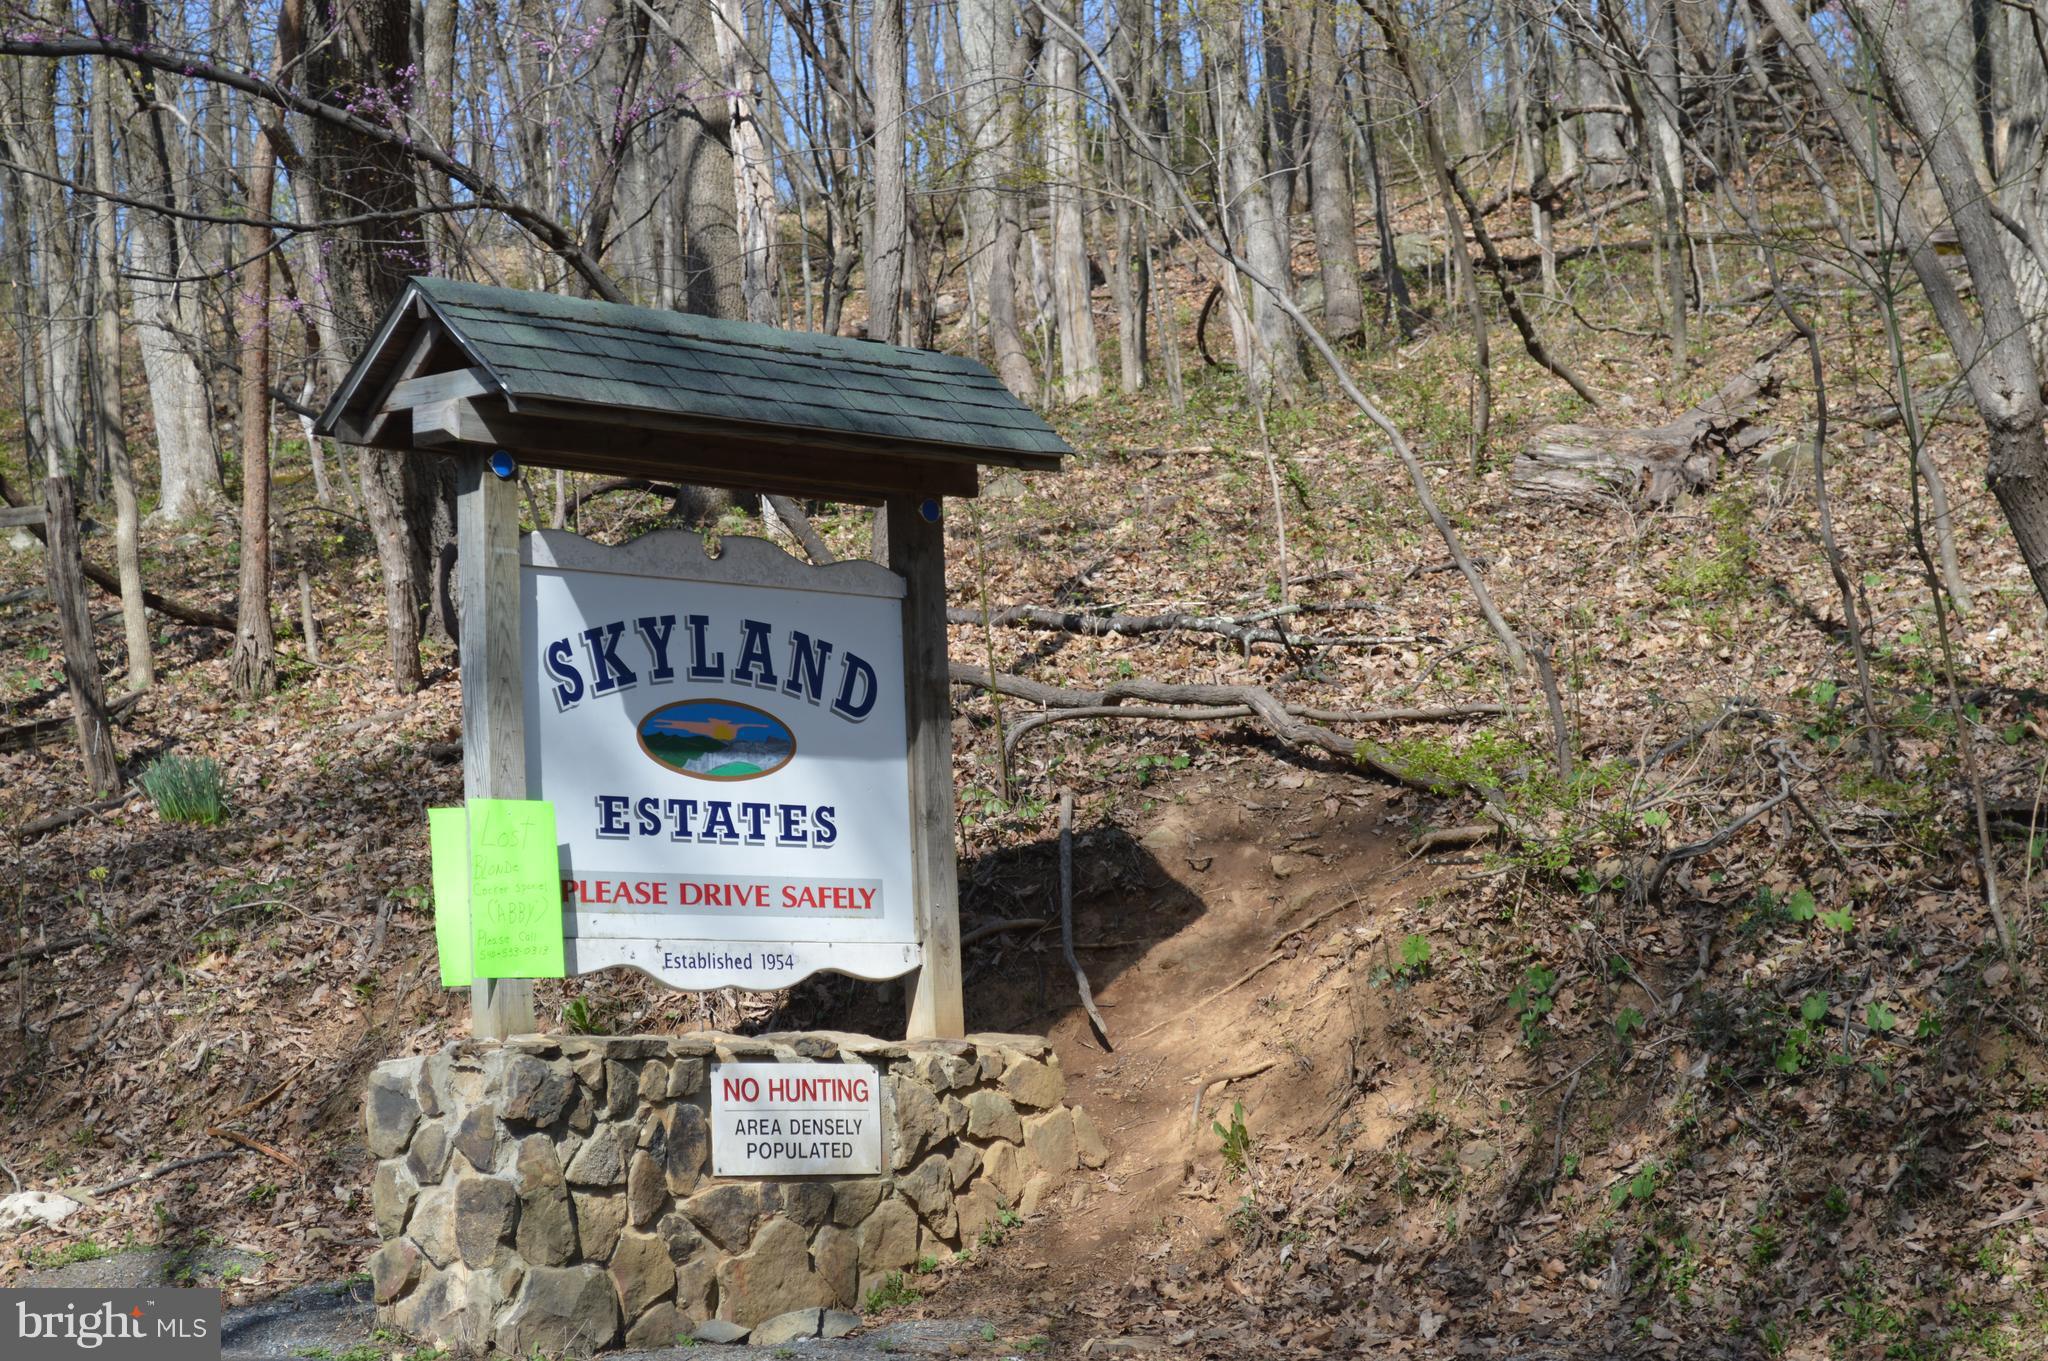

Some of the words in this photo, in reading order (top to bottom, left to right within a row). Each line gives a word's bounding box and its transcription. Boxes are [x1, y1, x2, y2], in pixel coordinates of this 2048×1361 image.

[544, 614, 878, 723] SKYLAND
[595, 795, 838, 848] ESTATES
[562, 879, 668, 905] PLEASE
[679, 882, 770, 908] DRIVE
[781, 885, 877, 910] SAFELY
[664, 952, 752, 971] Established
[761, 953, 794, 971] 1954
[723, 1077, 760, 1103] NO
[768, 1078, 869, 1103] HUNTING
[735, 1119, 782, 1136] AREA
[790, 1118, 863, 1136] DENSELY
[746, 1142, 853, 1160] POPULATED
